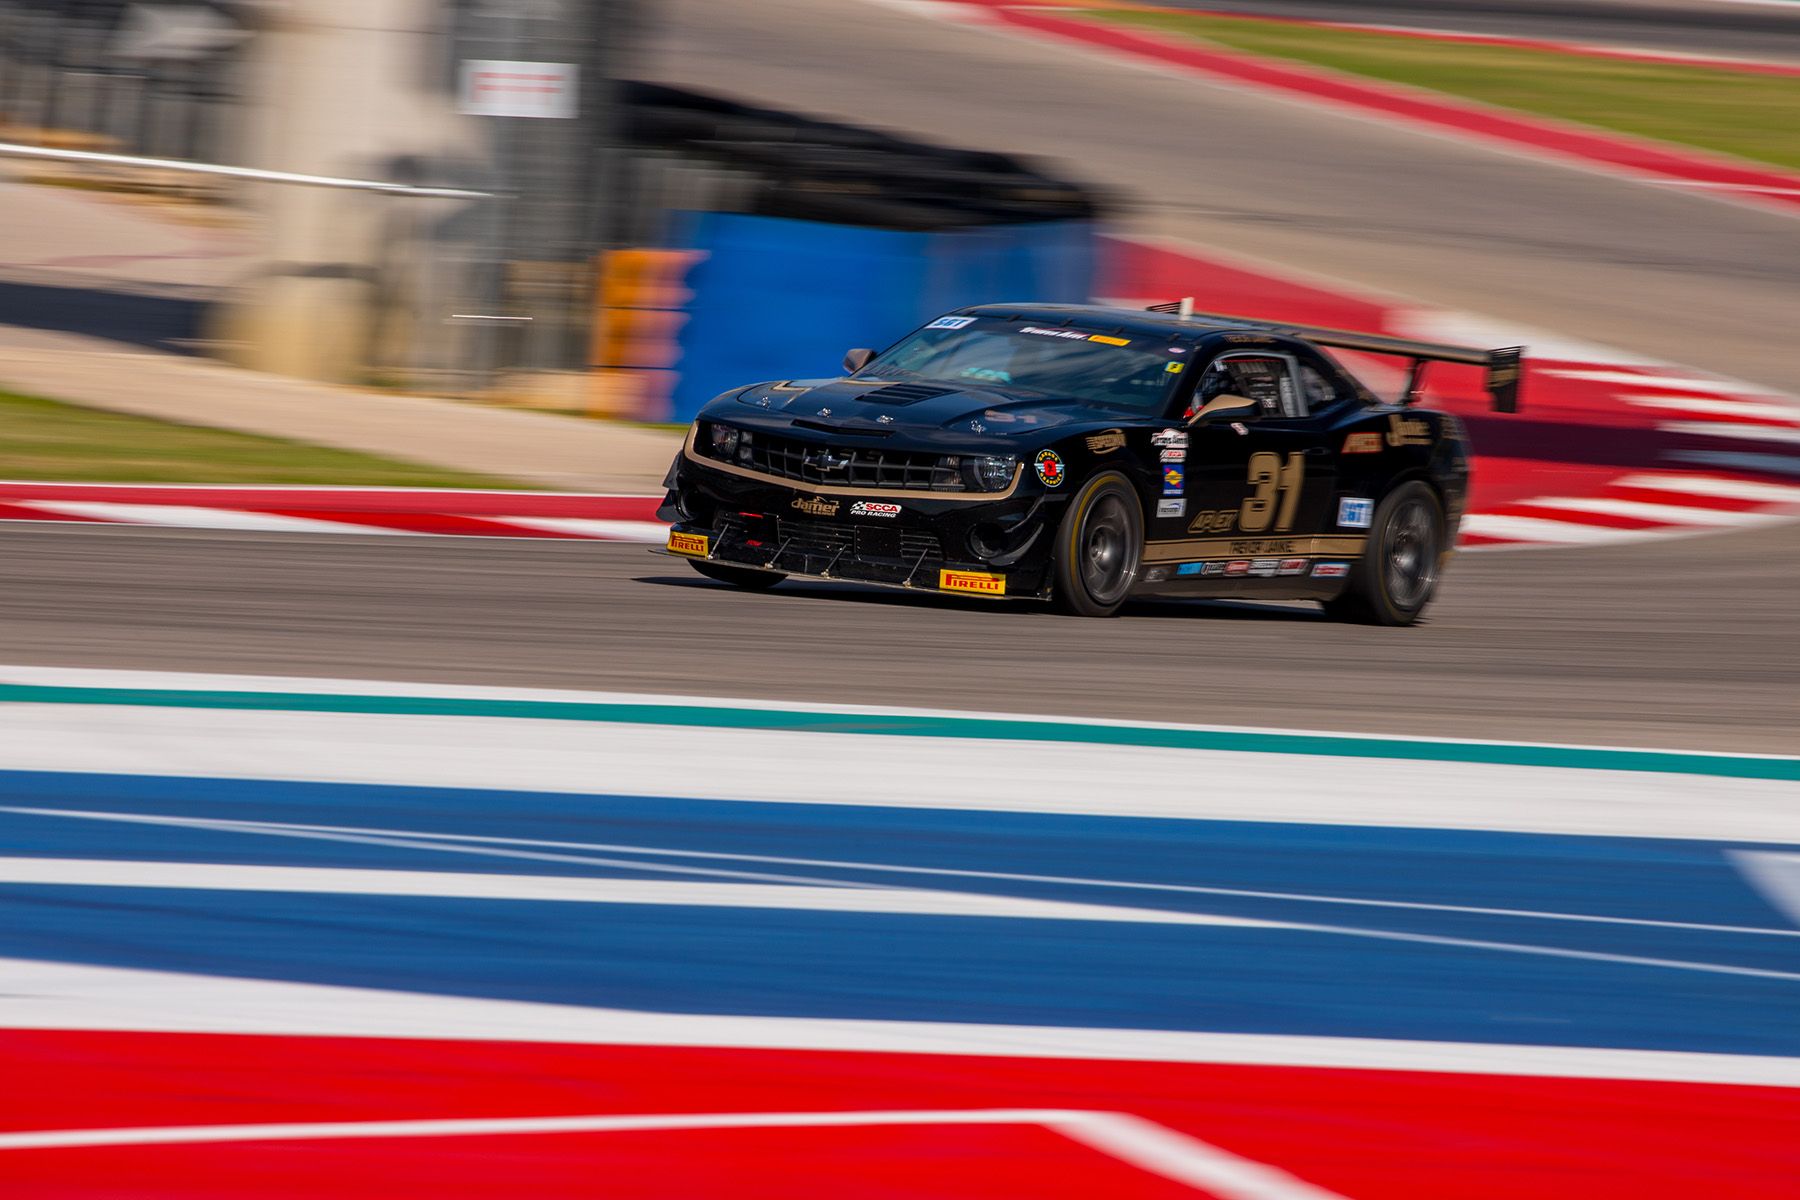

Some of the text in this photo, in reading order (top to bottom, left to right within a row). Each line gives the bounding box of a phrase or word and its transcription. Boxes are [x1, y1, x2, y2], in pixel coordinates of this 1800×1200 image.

[1239, 452, 1305, 532] 31
[865, 503, 898, 512] SCCA
[671, 534, 704, 552] PIRELLI
[945, 573, 999, 590] PIRELLI
